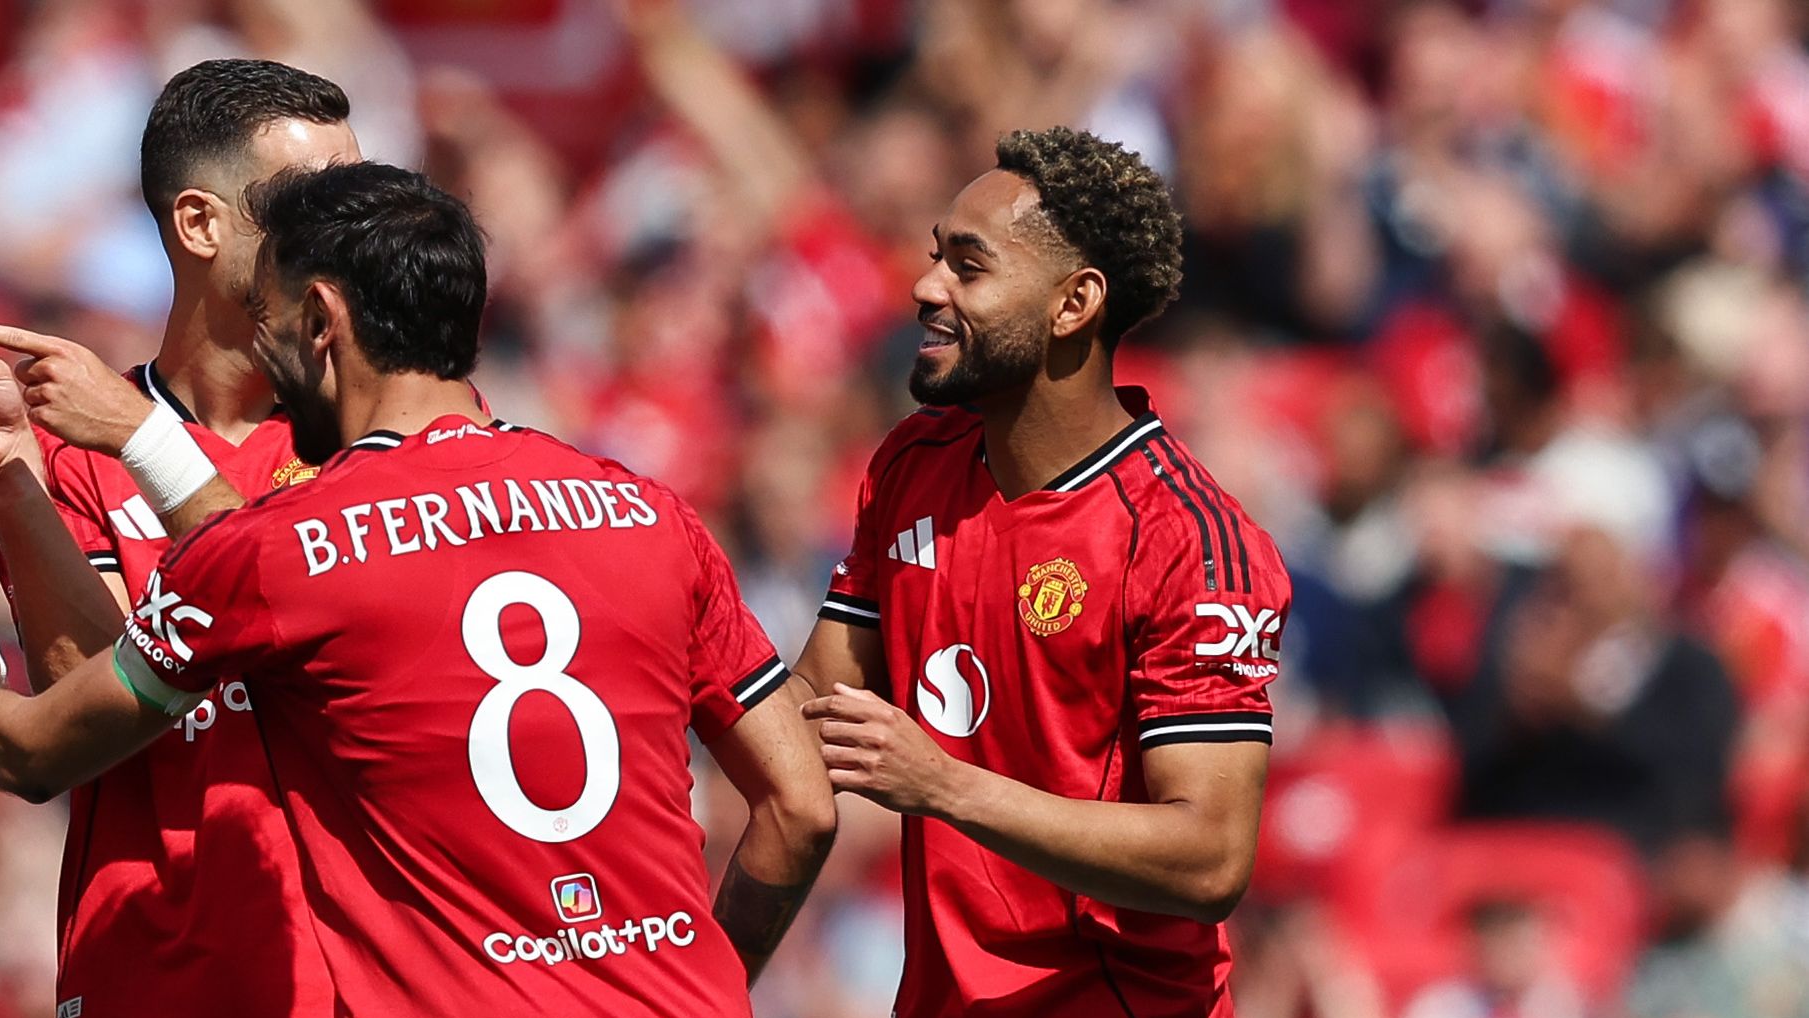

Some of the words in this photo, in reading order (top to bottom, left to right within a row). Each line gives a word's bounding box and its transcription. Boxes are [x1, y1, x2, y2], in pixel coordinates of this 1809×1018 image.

[293, 478, 658, 577] B.FERNANDES
[135, 567, 214, 663] XC
[1031, 563, 1082, 597] MANCHESTER
[1024, 611, 1061, 631] UNITED
[460, 569, 622, 843] 8
[482, 911, 695, 966] Copilot+PC
